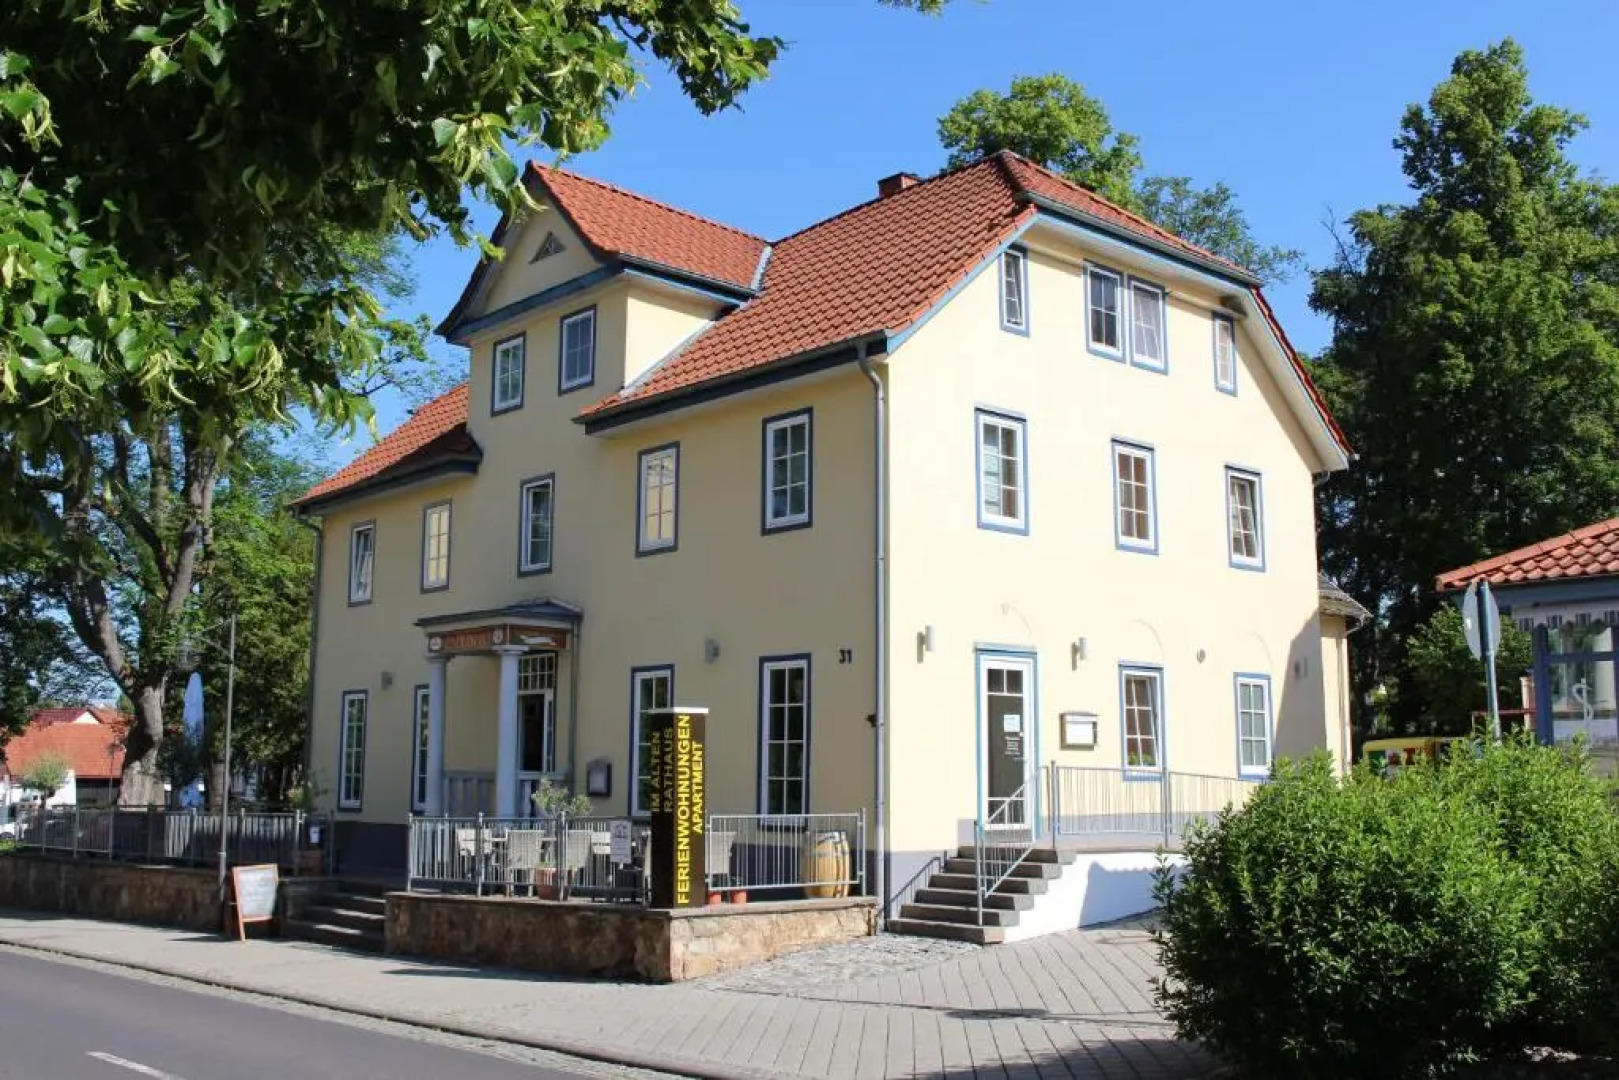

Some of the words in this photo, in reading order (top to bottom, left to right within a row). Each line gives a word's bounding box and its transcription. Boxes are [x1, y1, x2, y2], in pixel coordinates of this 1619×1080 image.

[651, 732, 660, 789] ALTEN
[651, 793, 660, 812] IM
[663, 727, 673, 813] RATHAUS
[691, 741, 703, 834] APARTMENT
[677, 715, 690, 904] FERIENWOHNUNGEN
